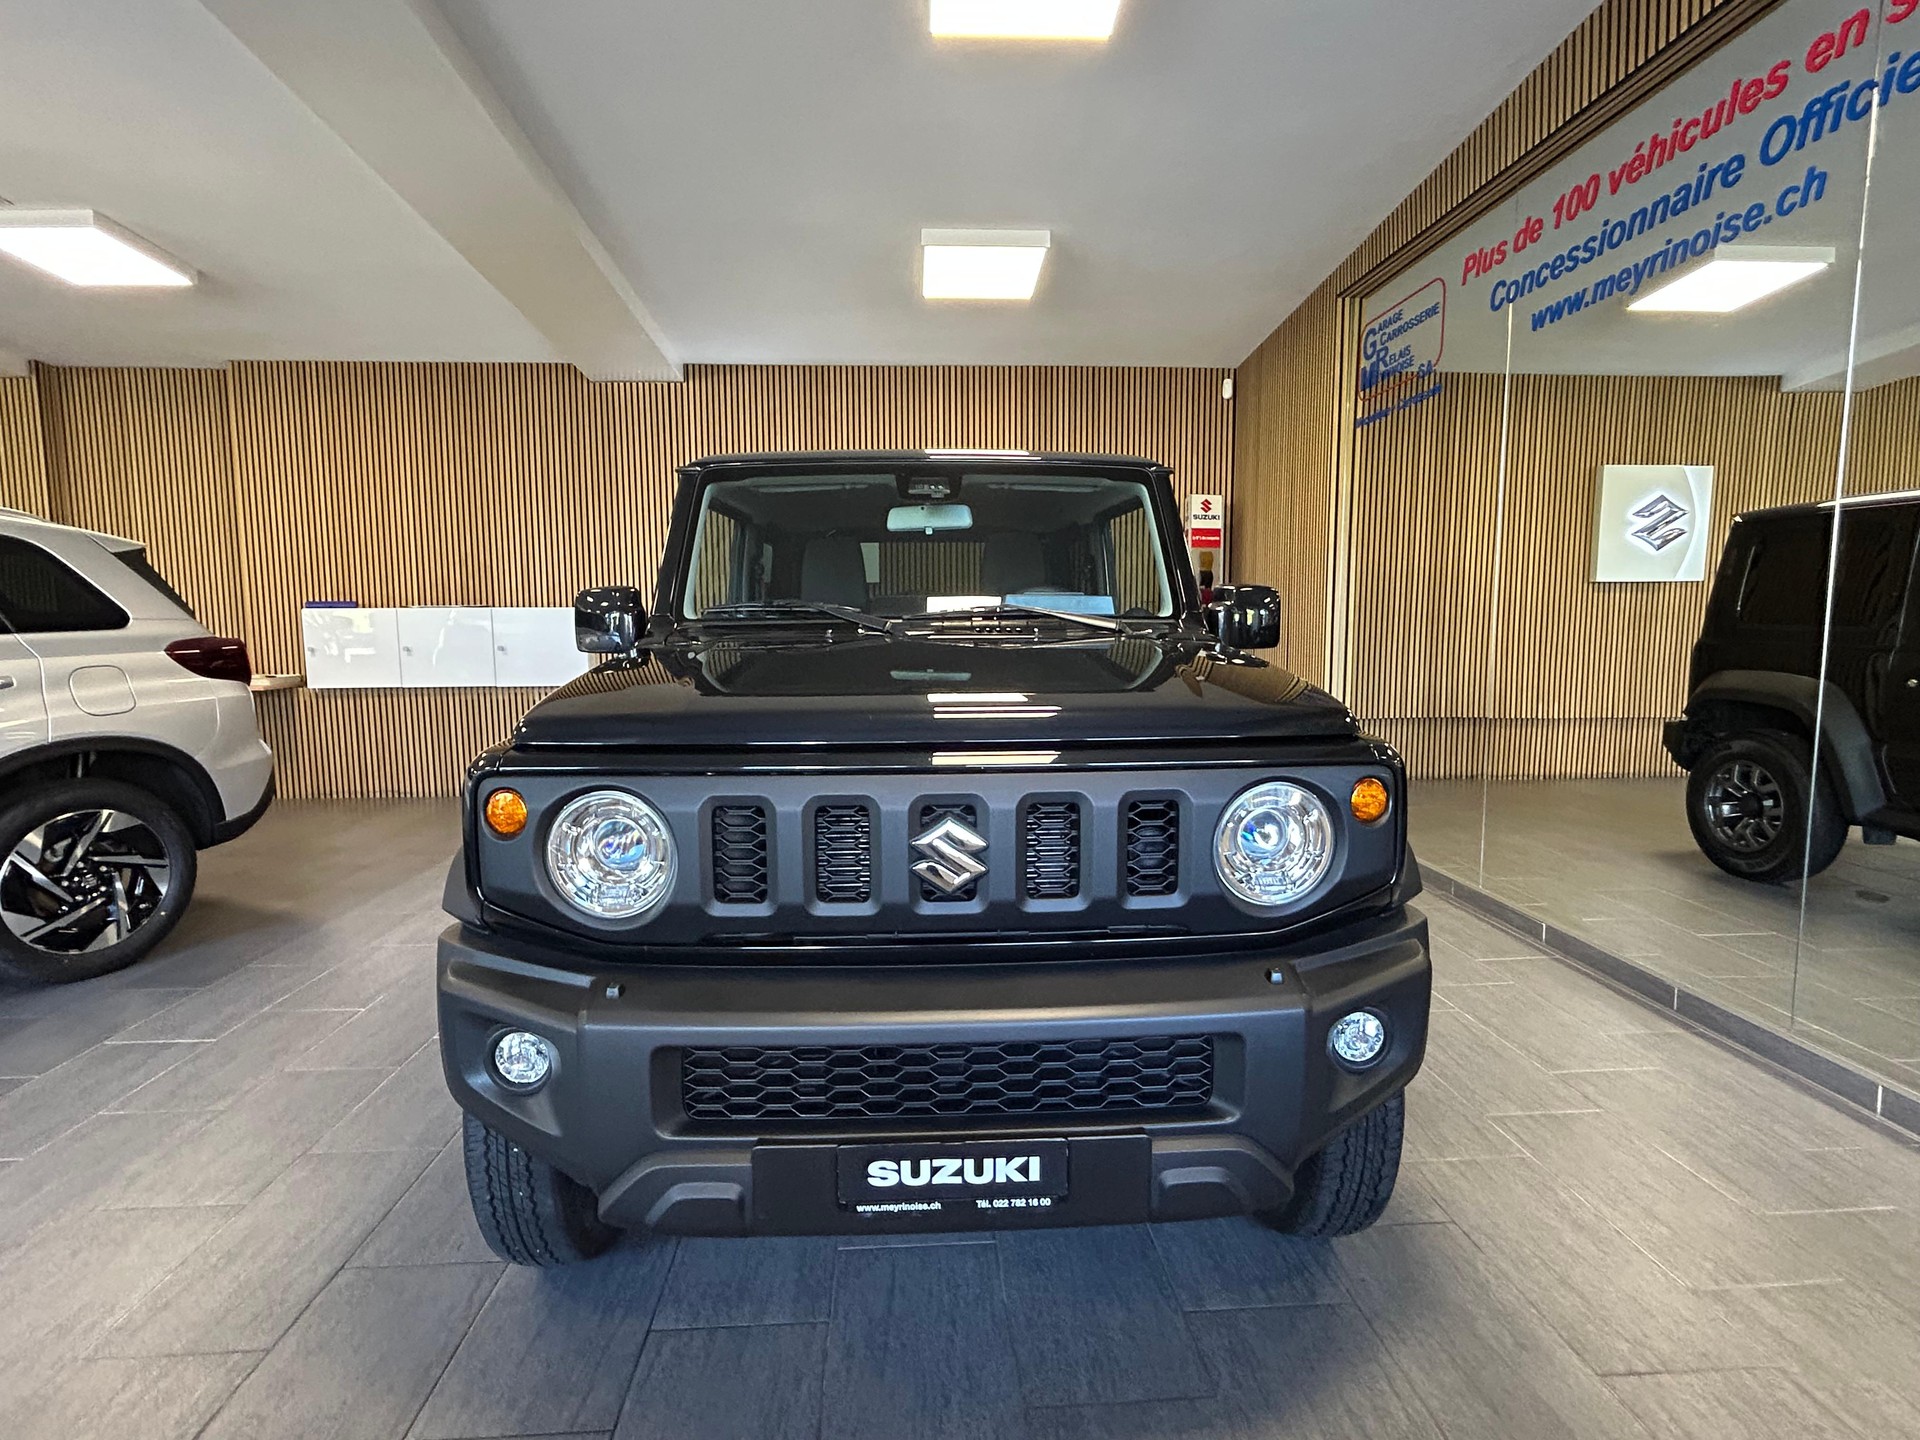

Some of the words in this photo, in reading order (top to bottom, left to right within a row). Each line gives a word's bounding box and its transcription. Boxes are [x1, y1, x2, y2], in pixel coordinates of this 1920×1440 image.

[1461, 240, 1508, 286] Plus
[1512, 216, 1544, 254] de
[1553, 173, 1601, 229] 100
[1608, 60, 1792, 196] véhicules
[1805, 8, 1870, 73] en
[1490, 154, 1746, 312] Concessionnaire
[1759, 51, 1920, 167] Officie
[1531, 166, 1828, 332] www.meyrinoise.ch
[1379, 302, 1440, 346] CARROSSERIE
[866, 1156, 1041, 1187] SUZUKI
[856, 1201, 942, 1213] www.meyrinoise.ch
[992, 1199, 1010, 1208] 022
[1010, 1198, 1027, 1207] 782
[1040, 1197, 1052, 1207] 00
